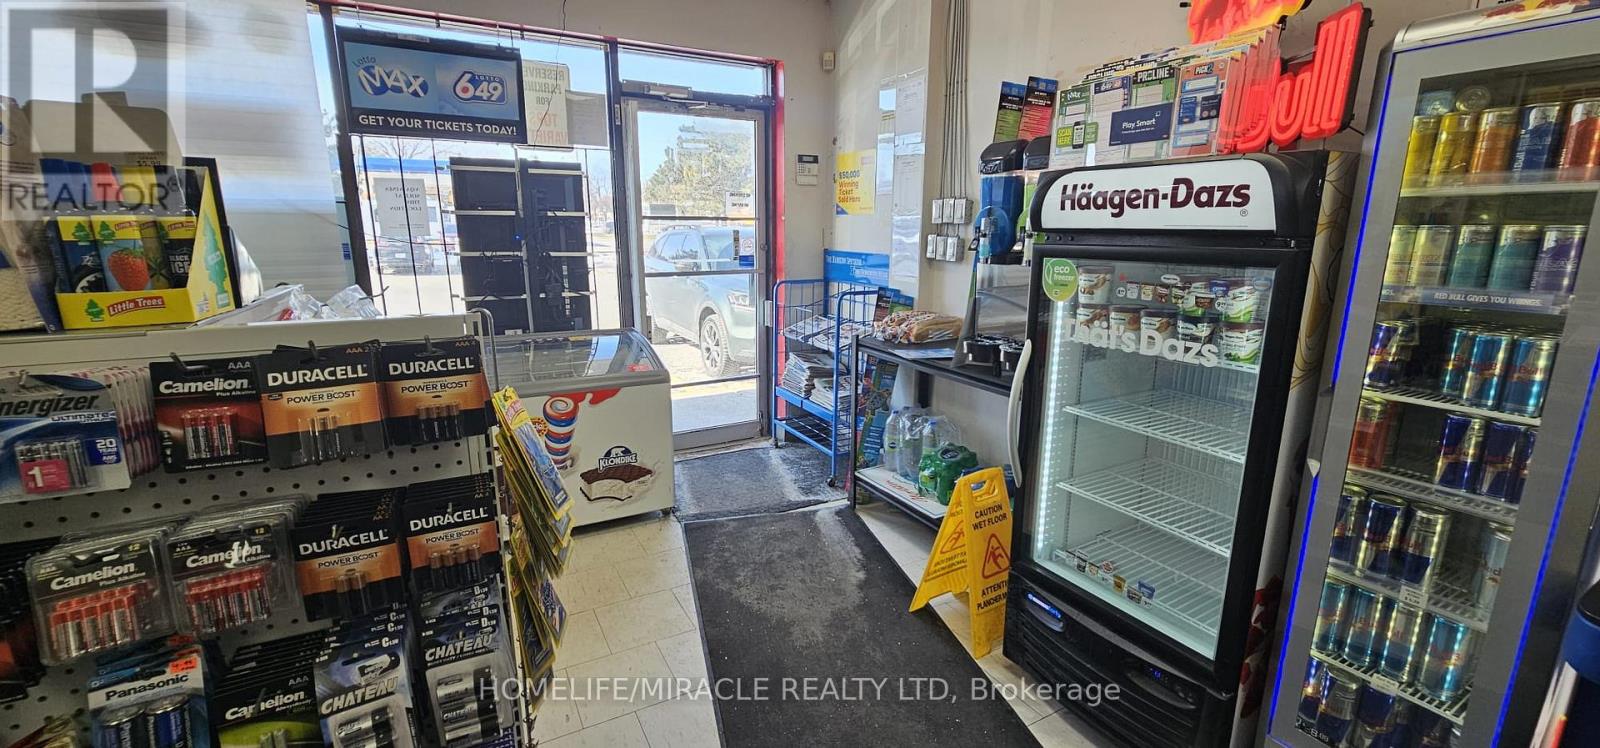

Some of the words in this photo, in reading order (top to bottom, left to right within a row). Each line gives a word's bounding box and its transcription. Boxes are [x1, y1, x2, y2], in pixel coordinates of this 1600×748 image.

[358, 64, 426, 98] MAX
[359, 115, 385, 126] GET
[387, 116, 422, 129] YOUR
[424, 119, 473, 132] TICKETS
[476, 123, 517, 136] TODAY!
[1122, 121, 1135, 130] Play
[1136, 118, 1156, 127] Smart
[1060, 177, 1250, 218] Häagen-Dazs
[109, 302, 135, 317] Little
[136, 296, 164, 307] Trees
[1434, 292, 1447, 300] RED
[1467, 294, 1487, 303] GIVES
[1489, 296, 1506, 304] YOU
[1140, 328, 1219, 368] Dazs
[228, 361, 251, 370] AAA
[388, 356, 475, 375] DURACELL
[267, 363, 368, 387] DURACELL
[159, 378, 249, 394] Camelion
[401, 384, 438, 394] POWER
[440, 380, 469, 390] BOOST
[287, 393, 324, 405] POWER
[327, 390, 356, 400] BOOST
[95, 438, 117, 449] 20
[599, 453, 637, 471] KLONDIKE
[27, 466, 44, 488] 1
[409, 507, 488, 532] DURACELL
[974, 503, 1003, 519] CAUTION
[972, 521, 987, 531] WET
[988, 513, 1008, 526] FLOOR
[299, 529, 389, 555] DURACELL
[425, 535, 455, 544] POWER
[456, 528, 480, 538] BOOST
[128, 543, 141, 552] 12
[186, 544, 261, 568] Cameon
[318, 556, 351, 569] POWER
[353, 551, 379, 562] BOOST
[51, 563, 135, 591] Camelion
[381, 637, 389, 647] C
[425, 634, 494, 661] CHATEAU
[105, 674, 189, 701] Panasonic
[288, 675, 309, 686] AAA
[321, 676, 398, 715] CHATEAU
